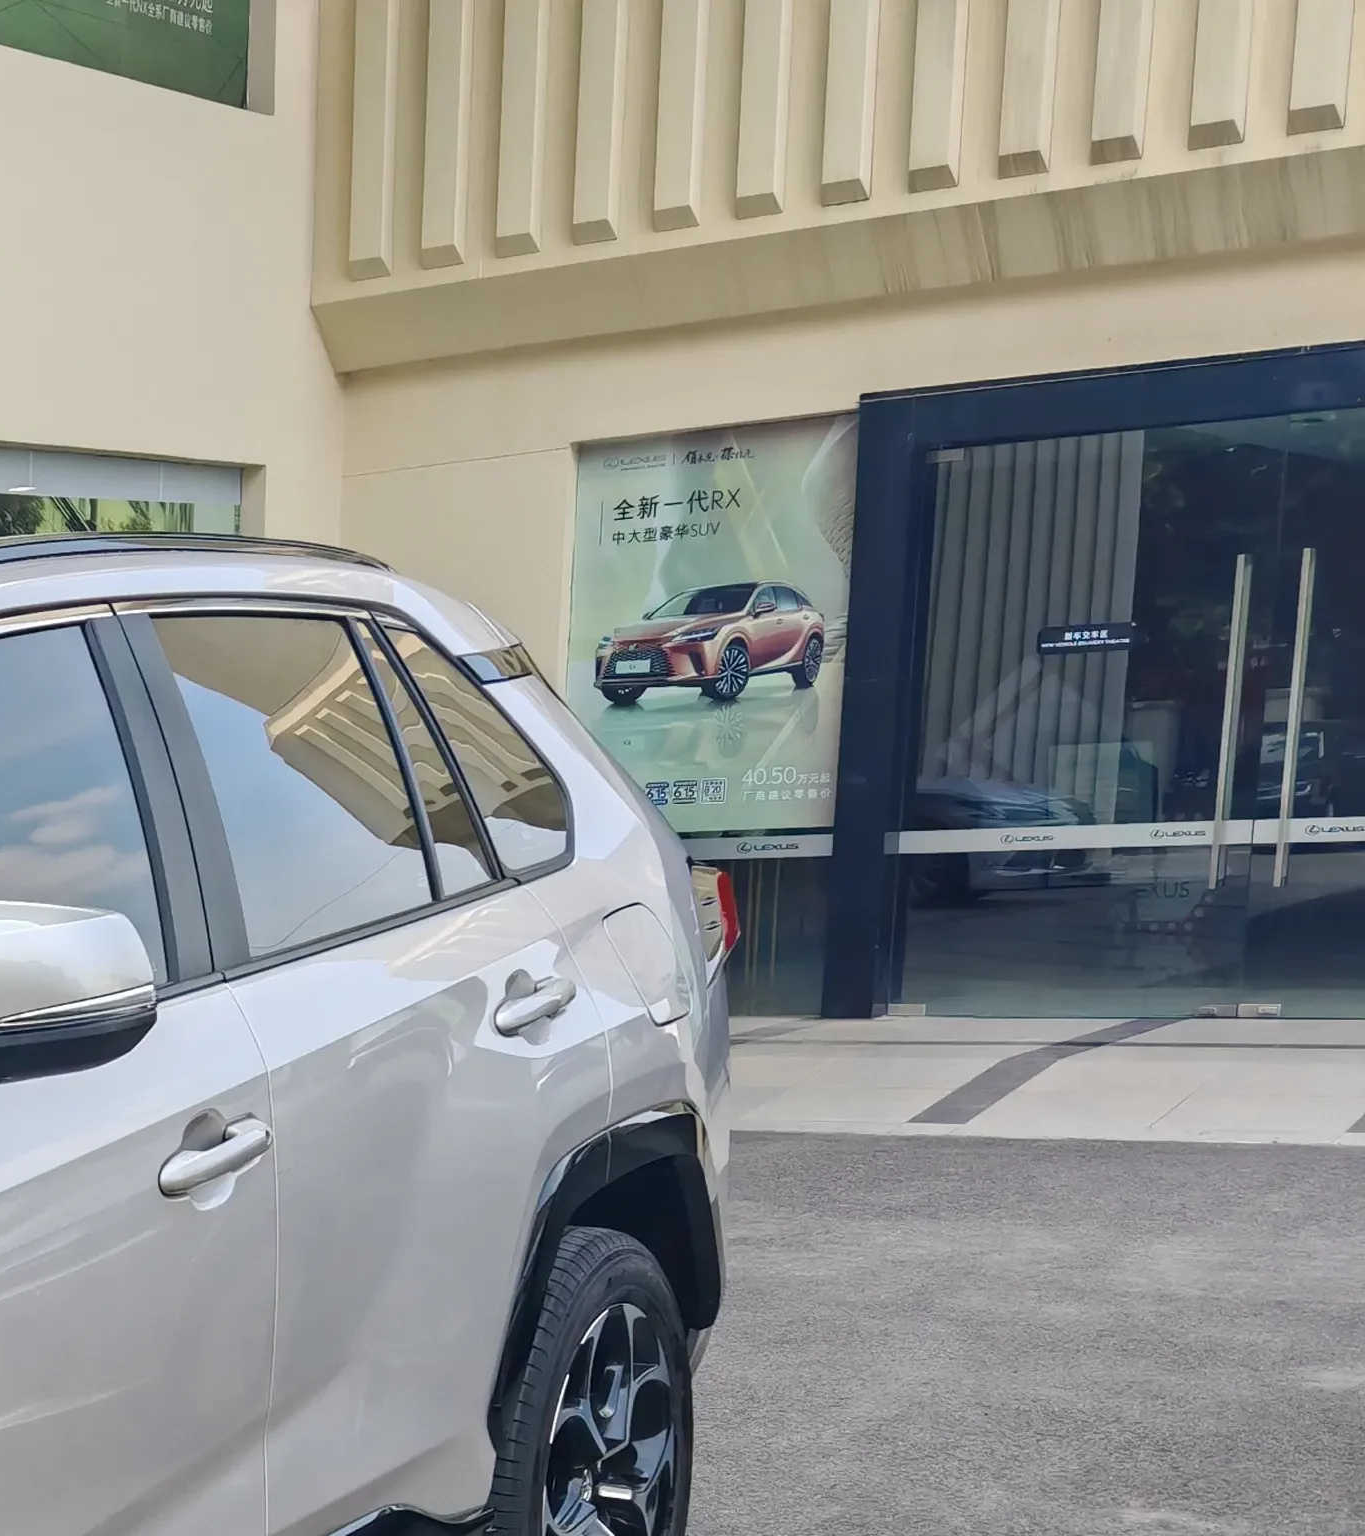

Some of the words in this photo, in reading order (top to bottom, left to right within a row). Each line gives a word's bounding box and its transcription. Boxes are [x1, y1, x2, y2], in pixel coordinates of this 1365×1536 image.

[613, 488, 741, 521] 全新一代RX
[612, 521, 721, 546] 中大型豪华SUV
[1321, 825, 1365, 833] LEXUS
[753, 843, 800, 851] LEXUS
